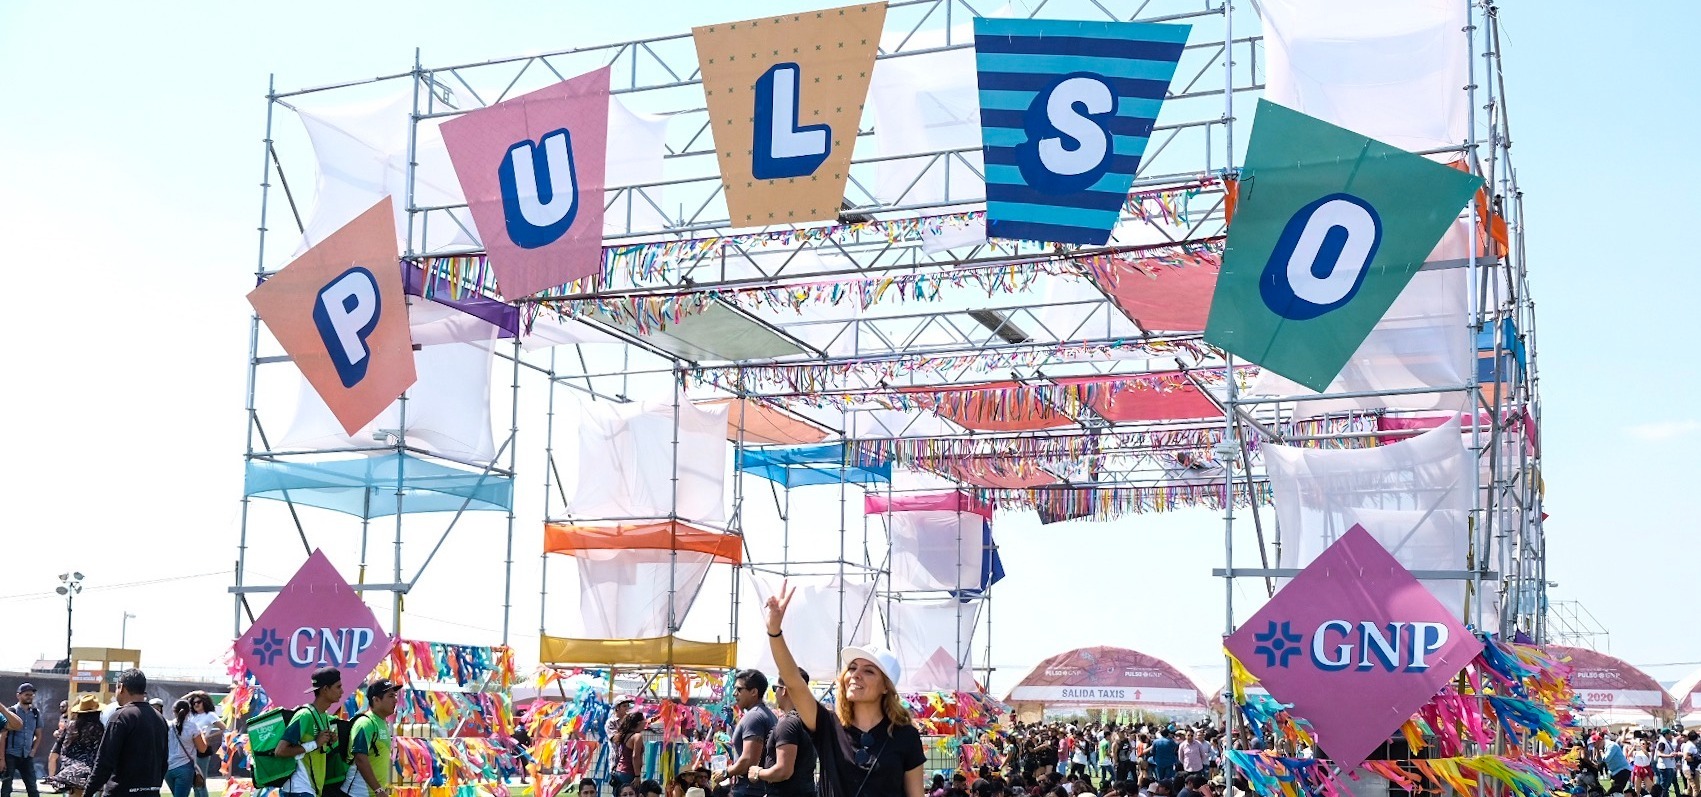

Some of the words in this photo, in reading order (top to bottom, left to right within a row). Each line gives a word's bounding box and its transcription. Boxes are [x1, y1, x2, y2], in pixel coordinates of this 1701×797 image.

[288, 626, 374, 668] GNP
[1310, 619, 1449, 673] GNP
[1062, 688, 1095, 698] SALIDA
[1098, 689, 1125, 699] TAXIS
[1587, 692, 1614, 702] 2020
